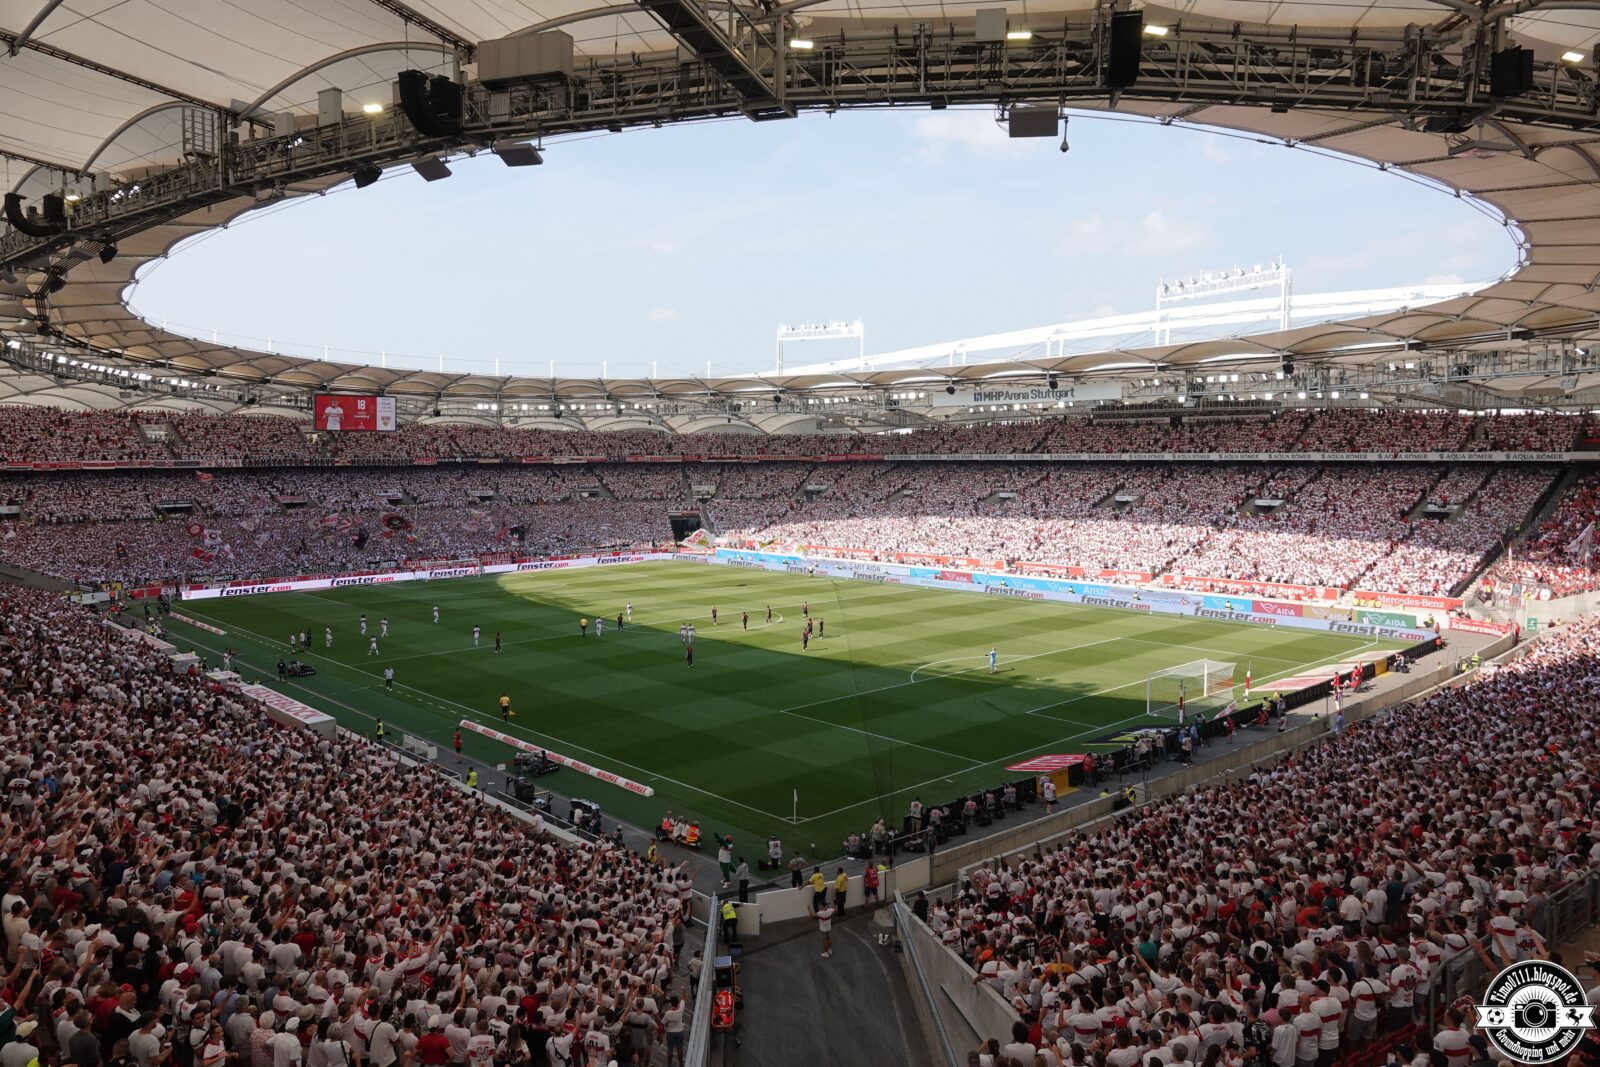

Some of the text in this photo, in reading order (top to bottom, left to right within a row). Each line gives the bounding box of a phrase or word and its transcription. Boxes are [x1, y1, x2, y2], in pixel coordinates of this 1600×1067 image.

[983, 387, 1074, 402] MHP Arena Stuttgart
[357, 400, 366, 410] 18
[517, 562, 569, 570] fenster.com
[727, 558, 765, 569] fenster.com
[330, 576, 394, 586] fenster.com
[852, 572, 900, 583] fenster.com
[220, 586, 291, 596] fenster.com
[984, 584, 1044, 599] fenster.com
[1081, 595, 1150, 610] fenster.com
[1377, 595, 1445, 608] Mercedes-Benz
[1194, 606, 1276, 624] fenster.com
[1385, 619, 1407, 628] AIDA
[1328, 620, 1425, 641] fenster.com
